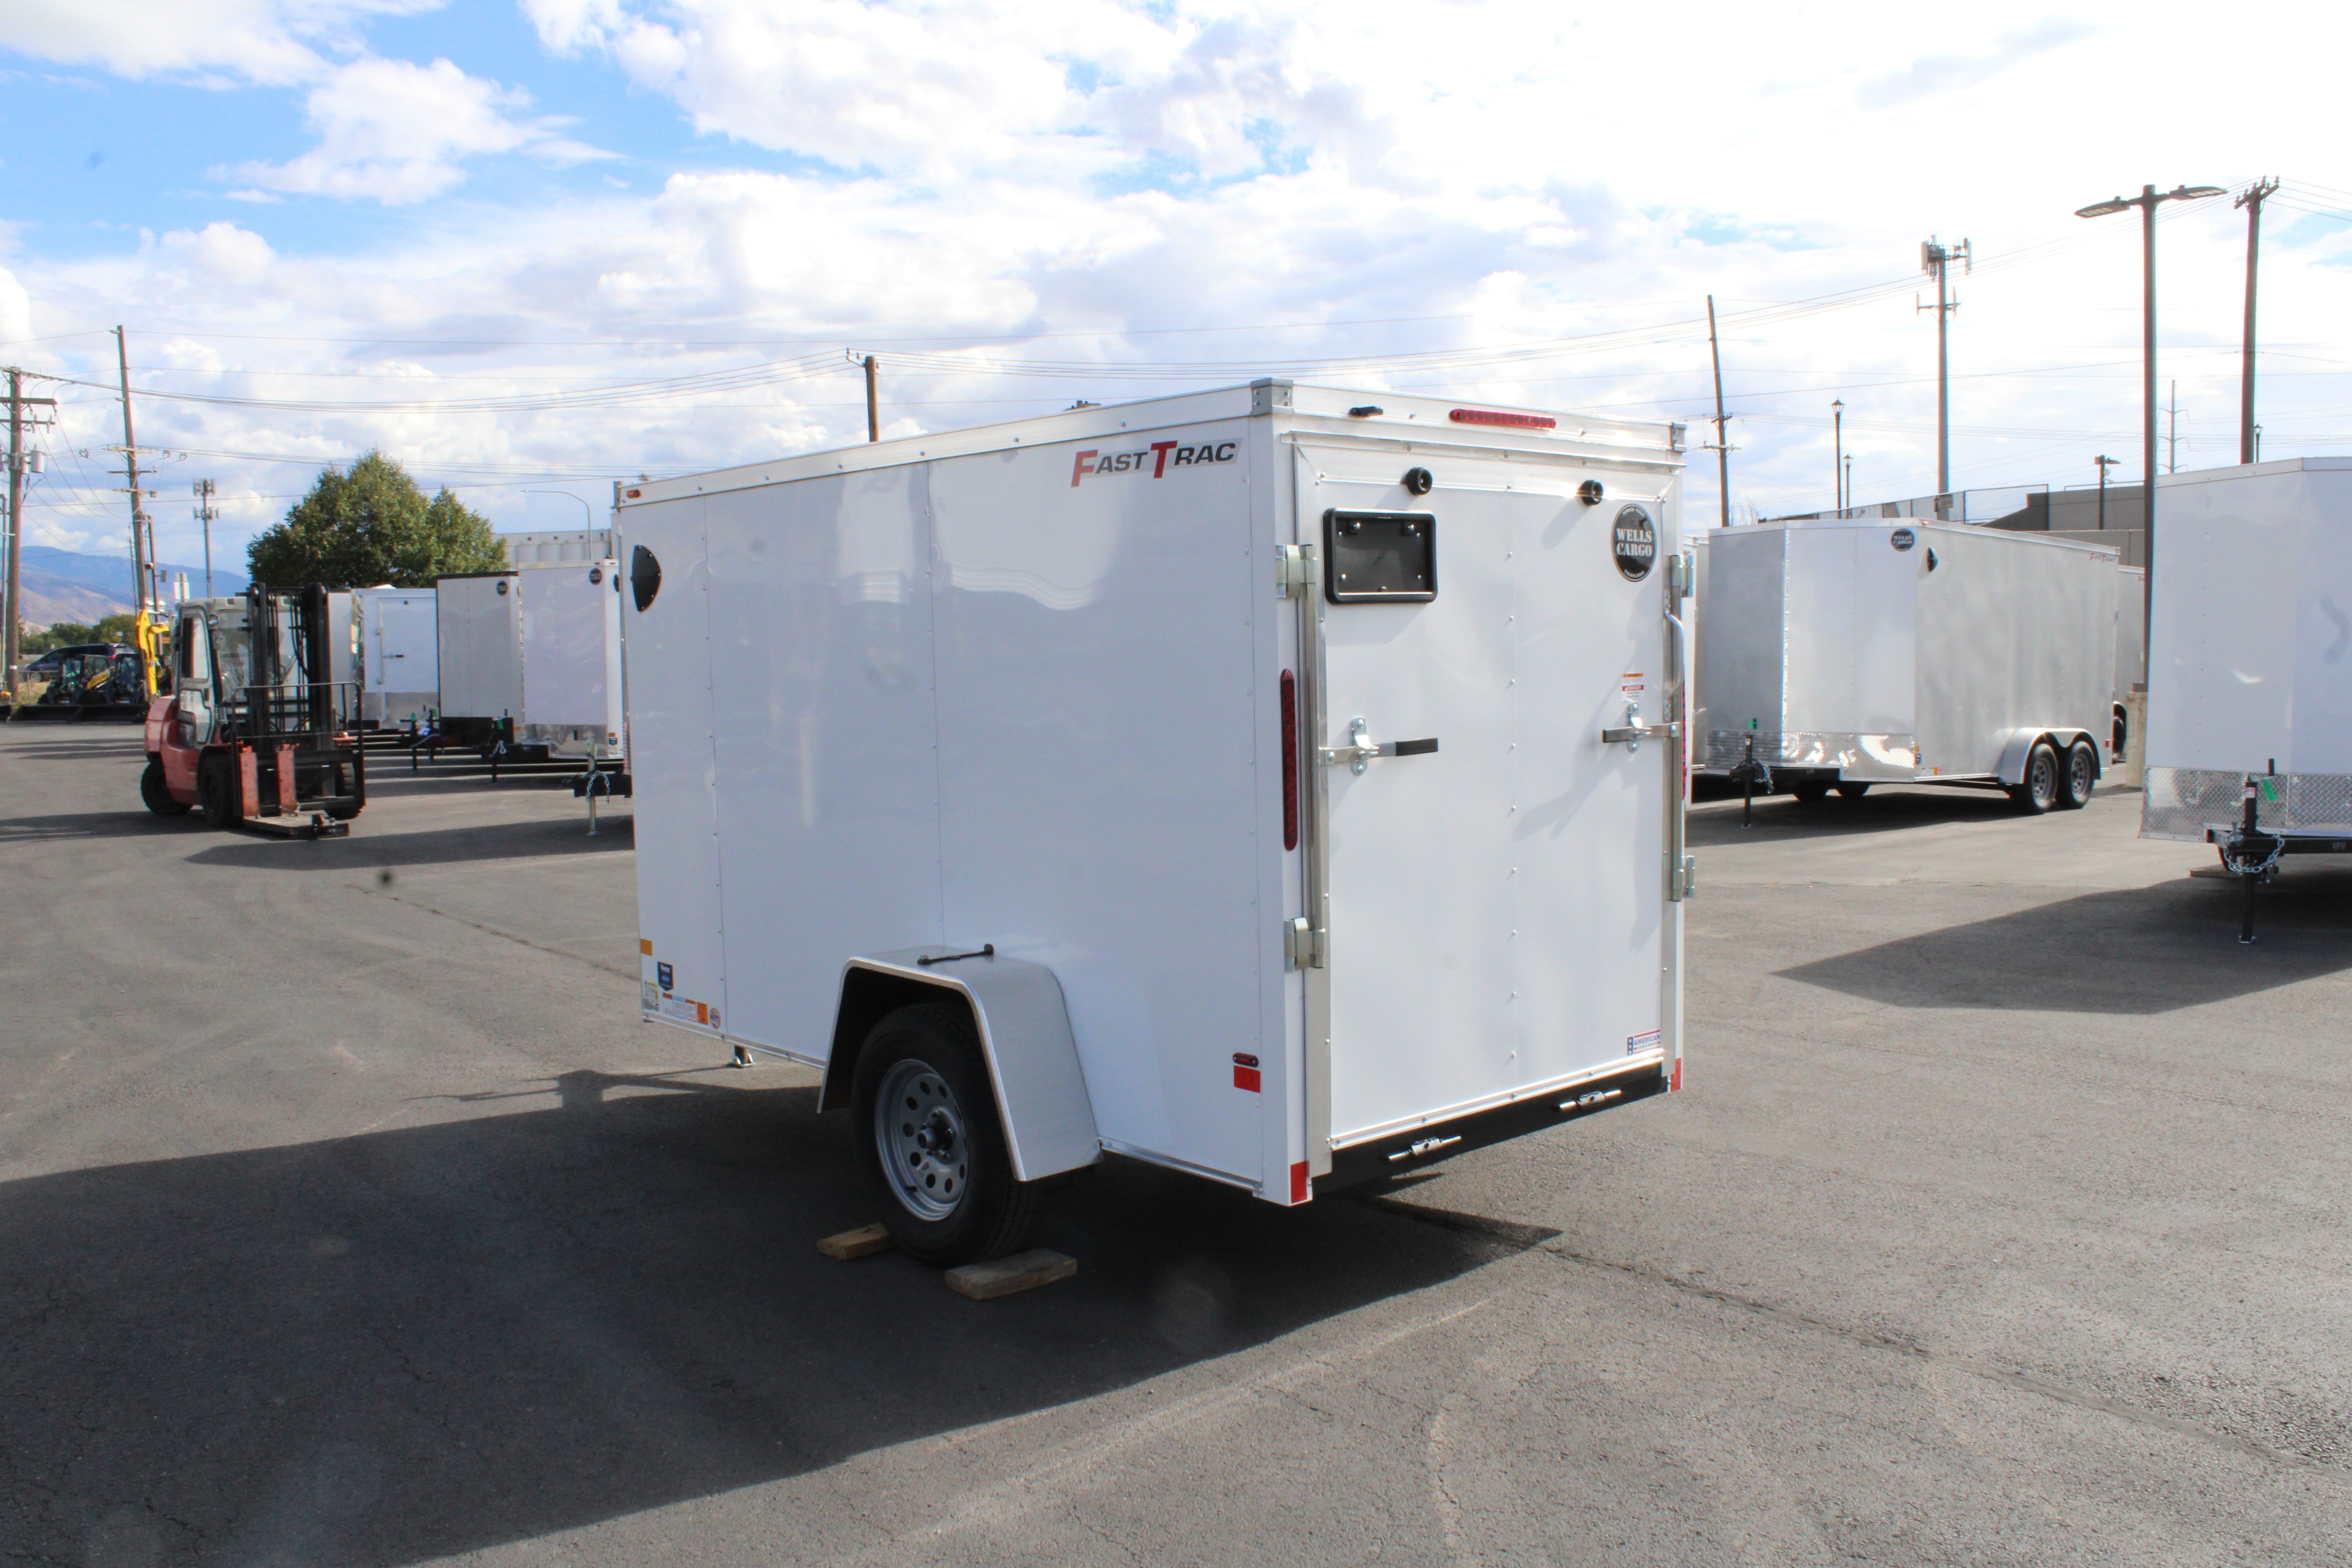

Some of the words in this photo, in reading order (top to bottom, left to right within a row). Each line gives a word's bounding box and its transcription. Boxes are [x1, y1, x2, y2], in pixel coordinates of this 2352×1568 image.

[1616, 528, 1652, 543] WELLS
[1616, 543, 1653, 557] CARGO
[1634, 1034, 1660, 1045] AMERICAN
